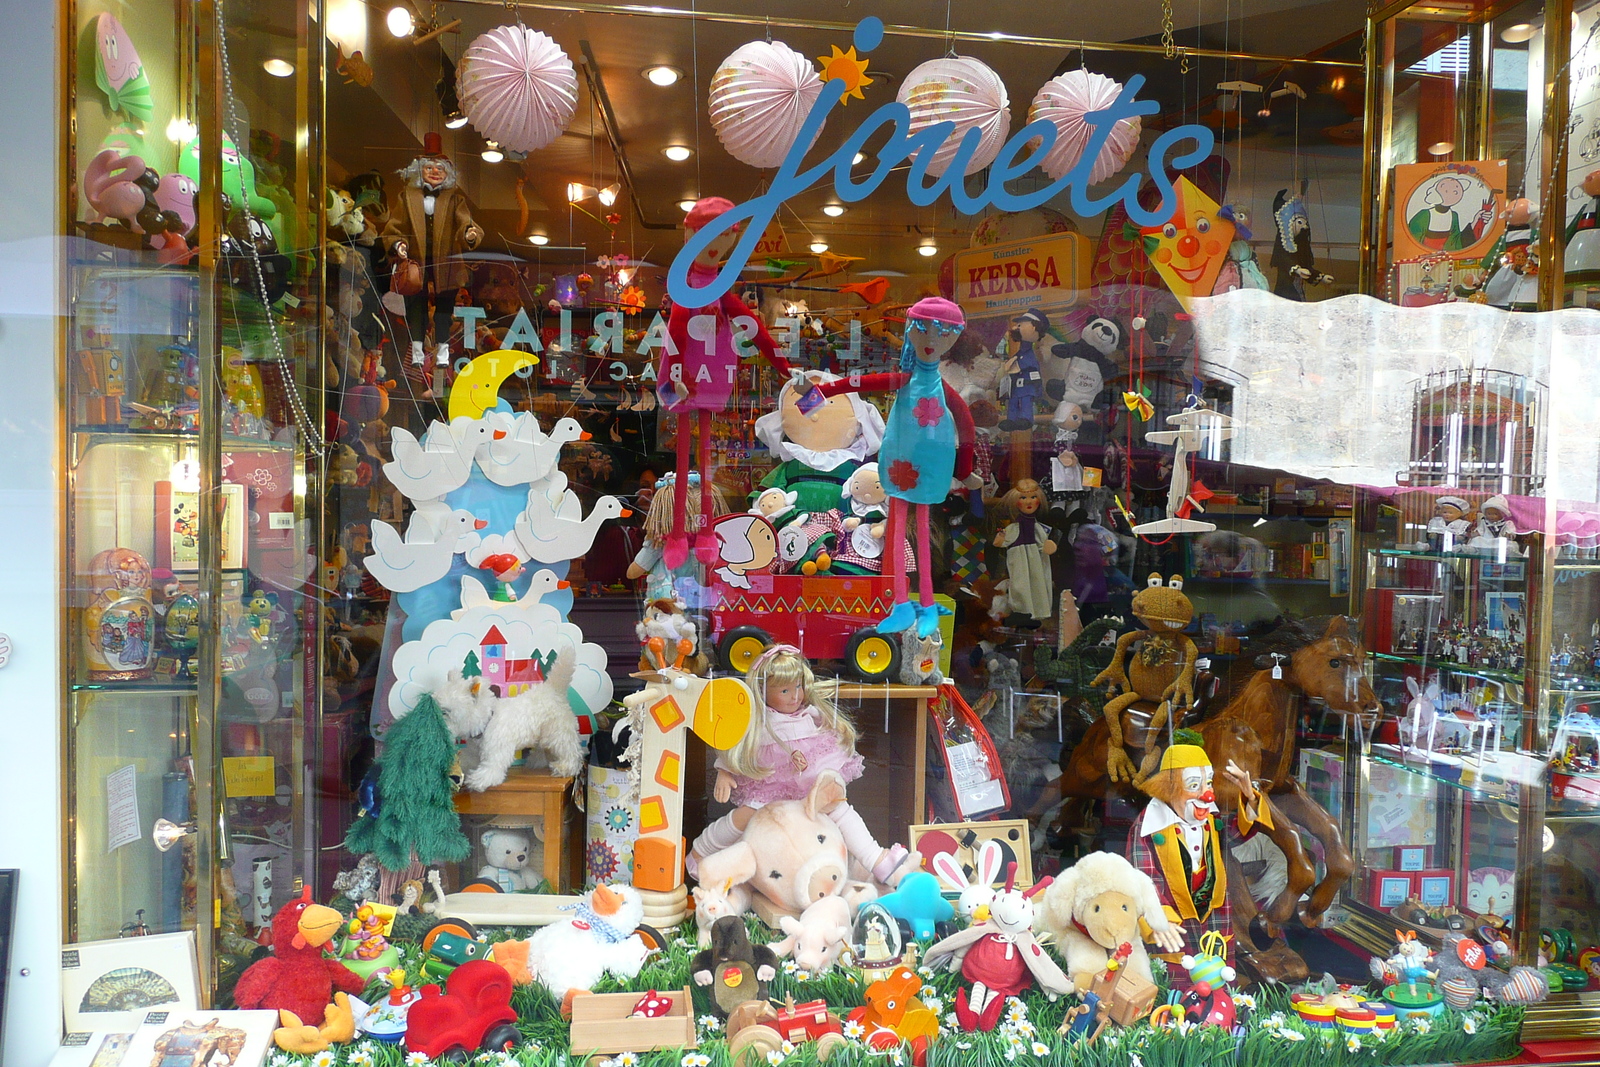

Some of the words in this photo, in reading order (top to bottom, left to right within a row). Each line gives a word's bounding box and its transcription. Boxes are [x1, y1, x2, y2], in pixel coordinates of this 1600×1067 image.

[667, 16, 1215, 309] jouets
[754, 231, 783, 254] evi
[968, 256, 1061, 299] KERSA
[985, 295, 1042, 309] Handpuppen
